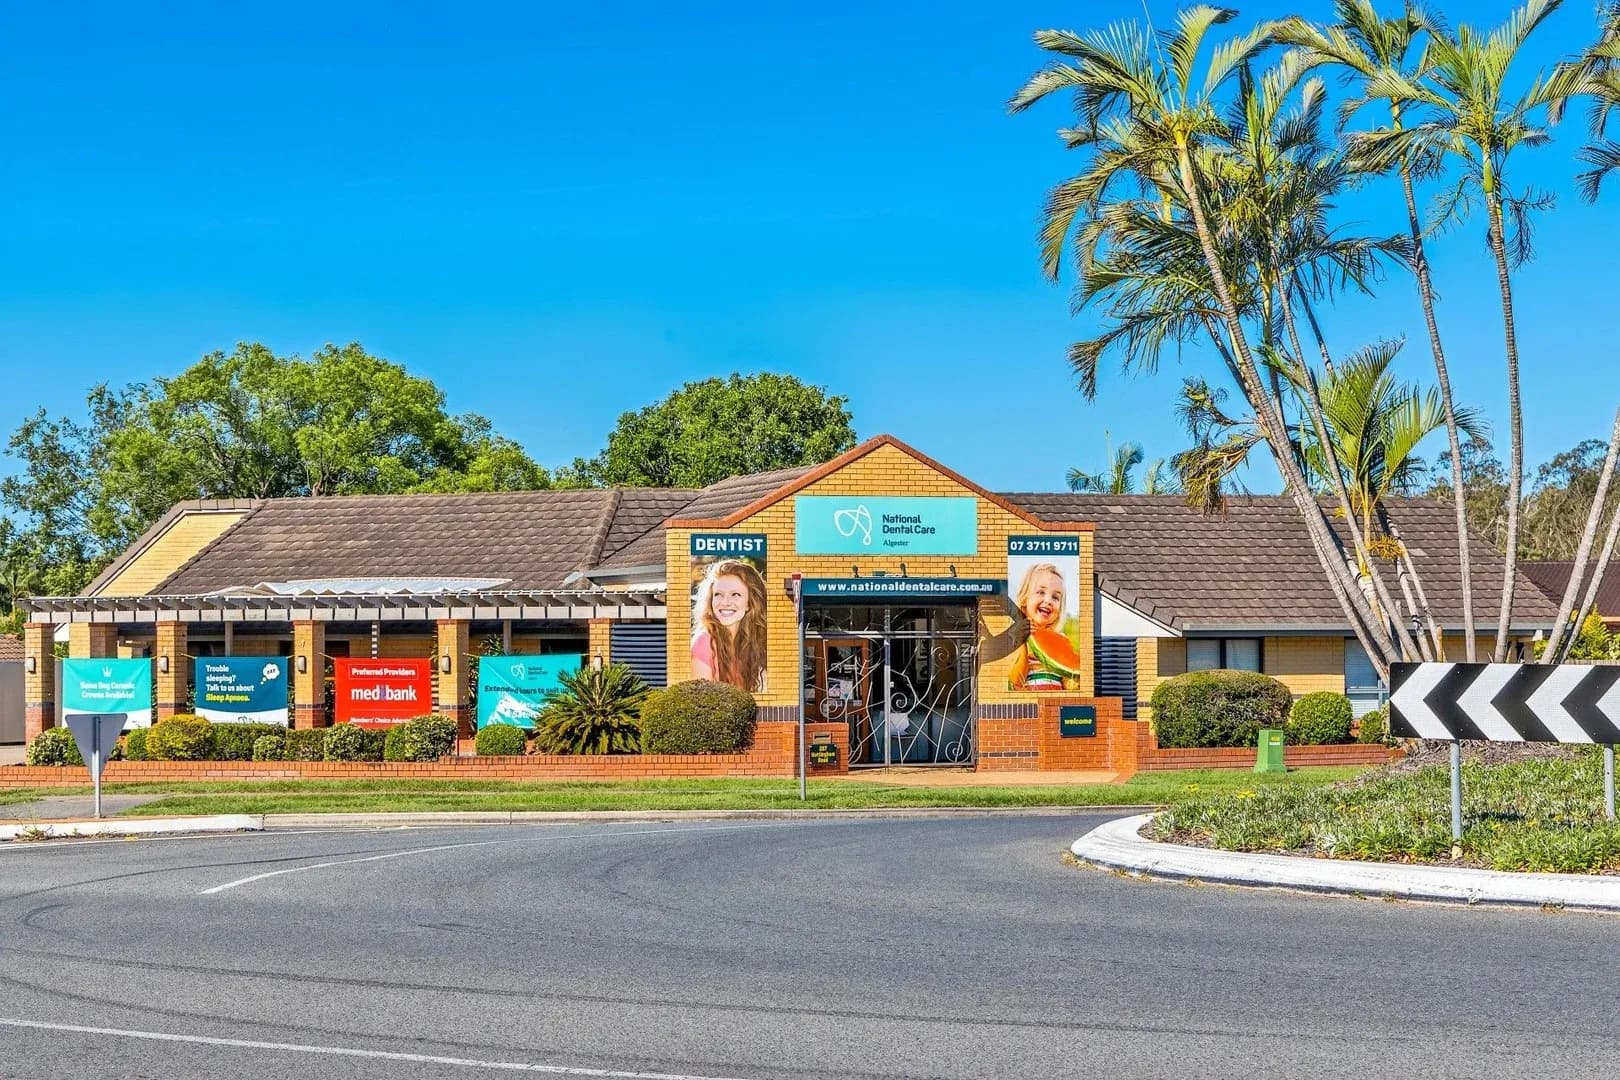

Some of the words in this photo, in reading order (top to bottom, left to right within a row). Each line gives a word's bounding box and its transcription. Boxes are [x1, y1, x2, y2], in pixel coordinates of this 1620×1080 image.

[882, 514, 921, 524] National
[882, 525, 913, 535] Dental
[914, 525, 936, 535] Care
[695, 538, 764, 552] DENTIST
[1010, 541, 1024, 551] 07
[1026, 541, 1051, 551] 3711
[1053, 541, 1078, 551] 9711
[818, 582, 993, 593] www.nationaldentalcare.com.au
[205, 664, 230, 673] Trouble
[351, 667, 384, 676] Preferred
[384, 667, 416, 676] Providers
[205, 674, 237, 684] sleeping?
[206, 684, 220, 692] Talk
[220, 684, 227, 692] to
[228, 684, 235, 692] us
[236, 684, 255, 692] about
[351, 685, 417, 701] medibank
[484, 684, 519, 694] Extended
[206, 693, 225, 703] Sleep
[1064, 717, 1093, 725] welcome
